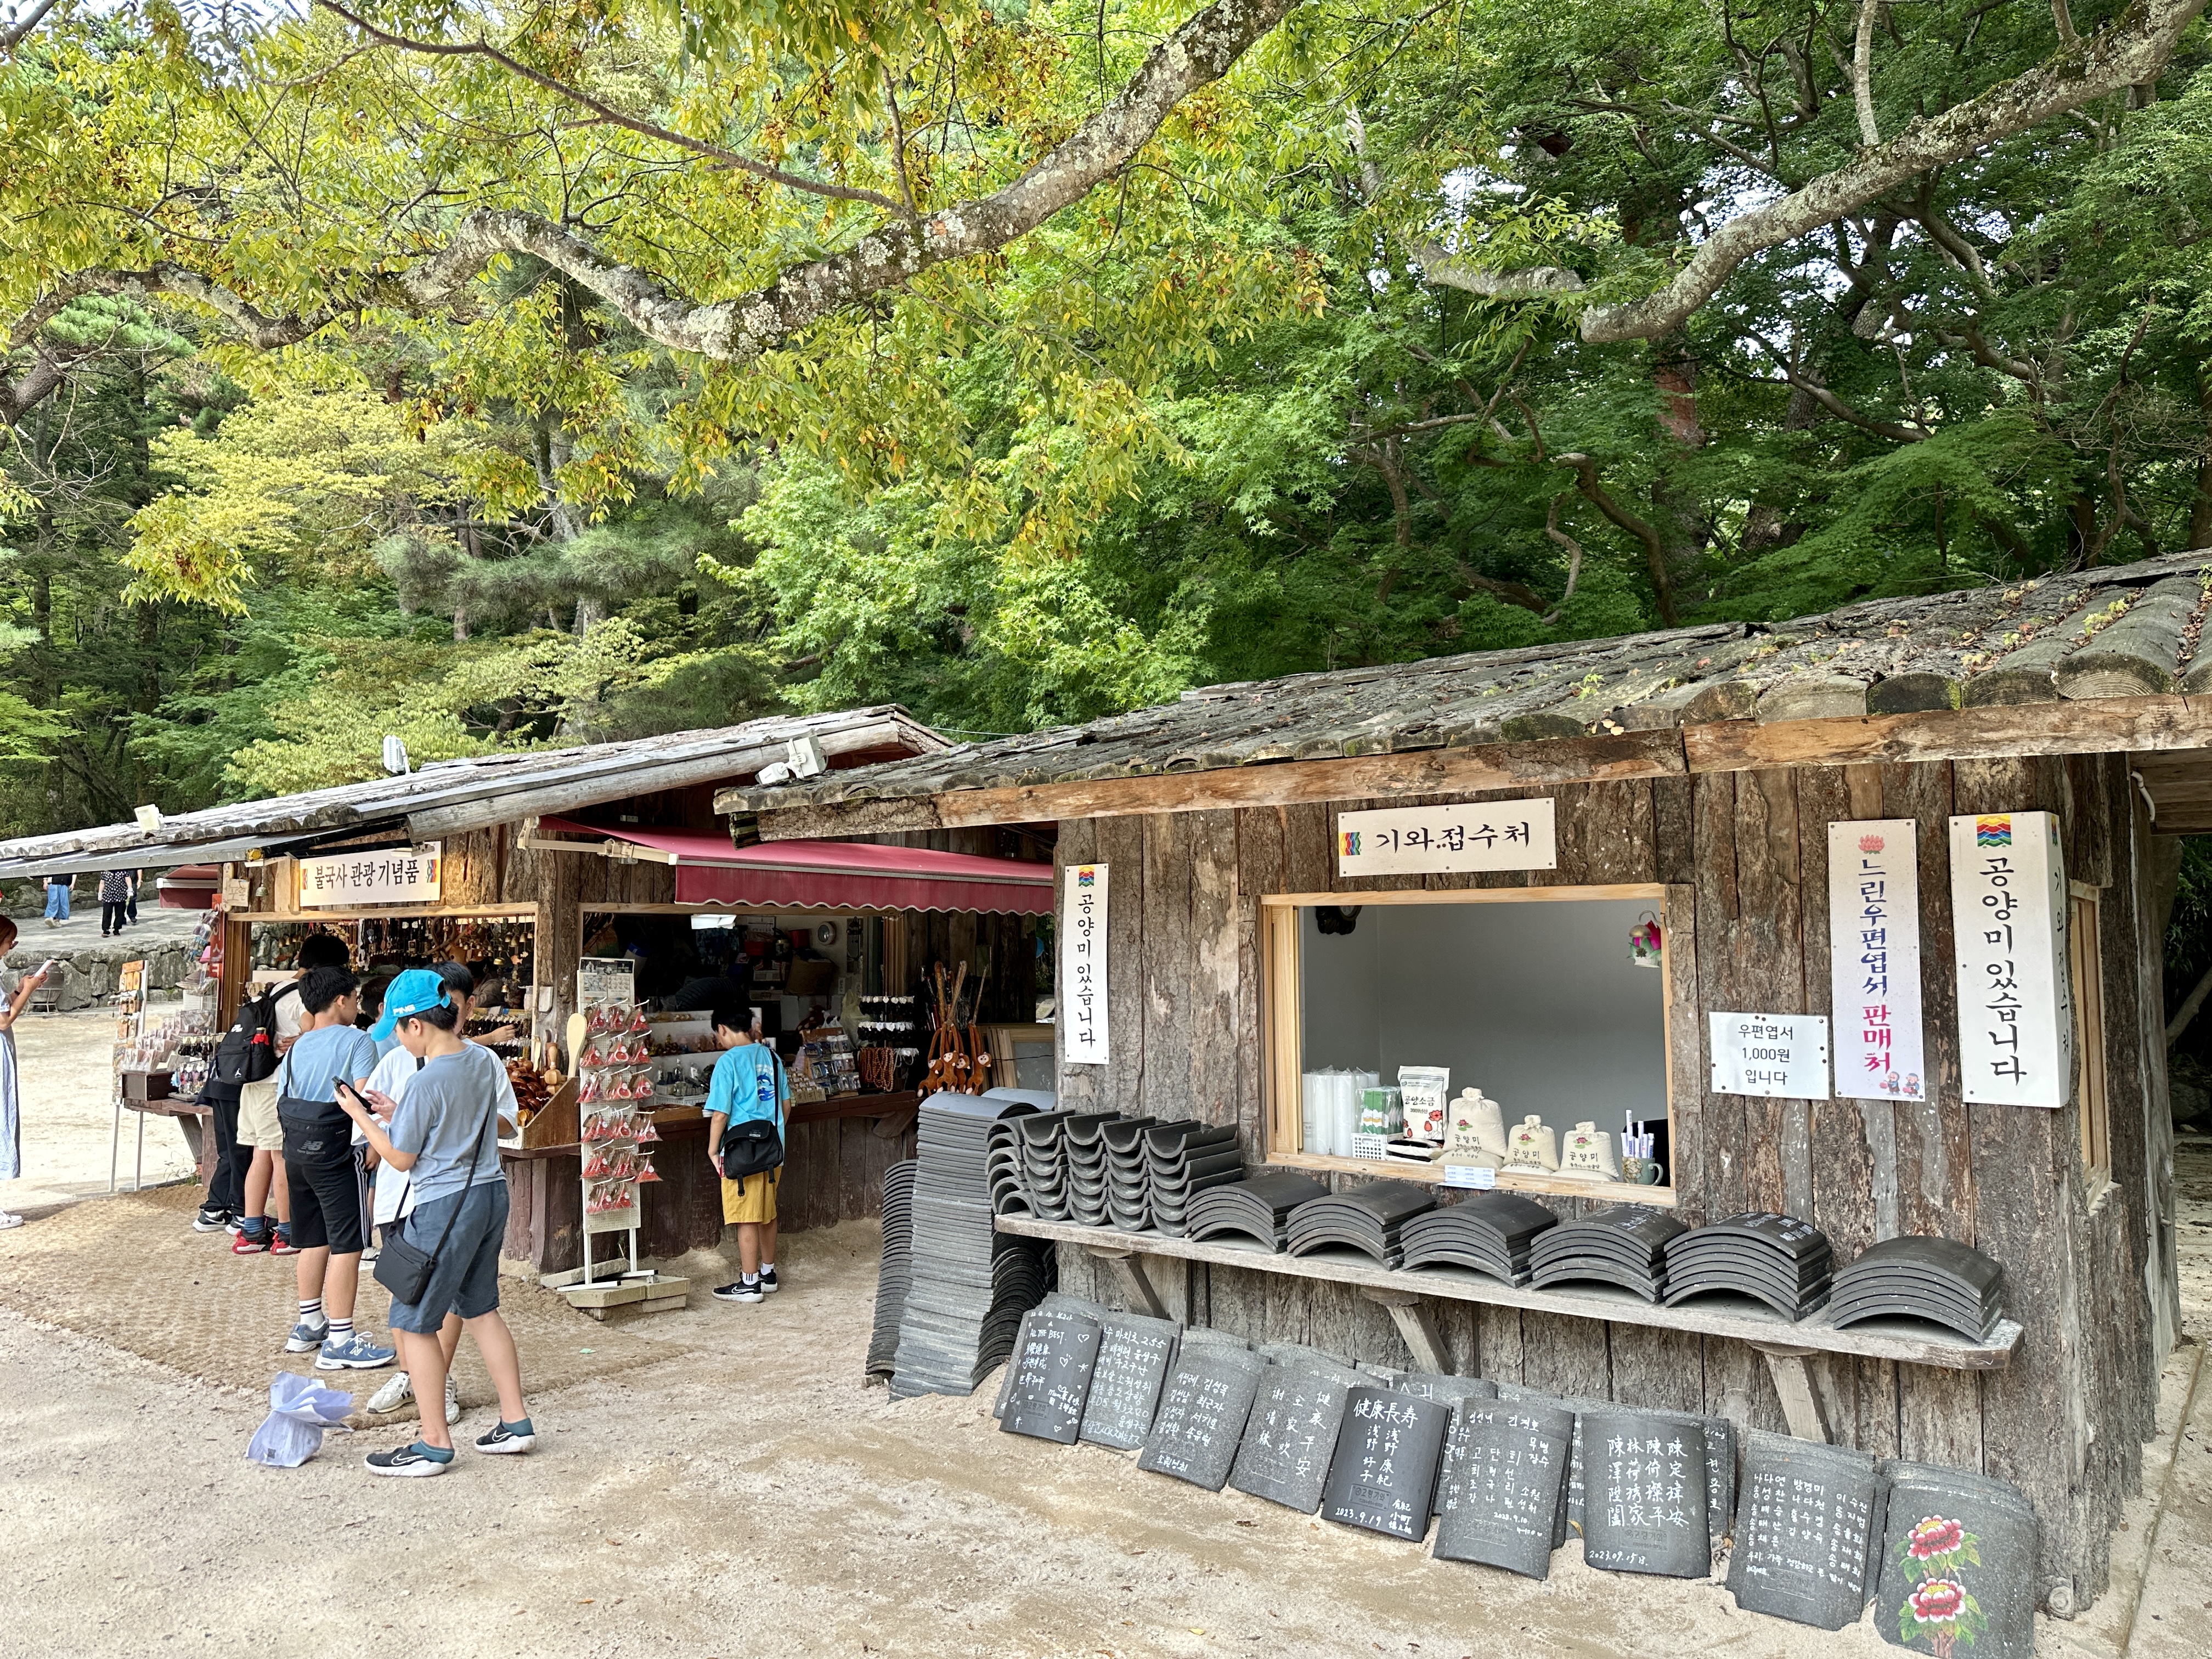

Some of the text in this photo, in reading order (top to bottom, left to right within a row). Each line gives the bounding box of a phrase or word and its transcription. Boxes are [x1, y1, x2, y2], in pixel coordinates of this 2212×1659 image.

[315, 859, 420, 889] 불국사 관광 기념품
[1076, 894, 1096, 1049] 공양미 있습니다
[1858, 859, 1892, 1074] 느린우편엽서 판매처
[1979, 857, 2028, 1086] 공양미 있습니다
[392, 1004, 416, 1016] PING
[1738, 1024, 1793, 1040] 우편엽서
[1741, 1047, 1790, 1063] 1,000원
[1745, 1069, 1788, 1086] 입니다
[1404, 1096, 1435, 1107] 공양소금
[1454, 1133, 1480, 1146] 공양미
[1513, 1148, 1539, 1160] 공양미
[1569, 1151, 1598, 1163] 공양미
[1141, 1336, 1167, 1348] 255
[1353, 1397, 1418, 1429] 健康長寿
[1335, 1507, 1382, 1527] 2023.9.19
